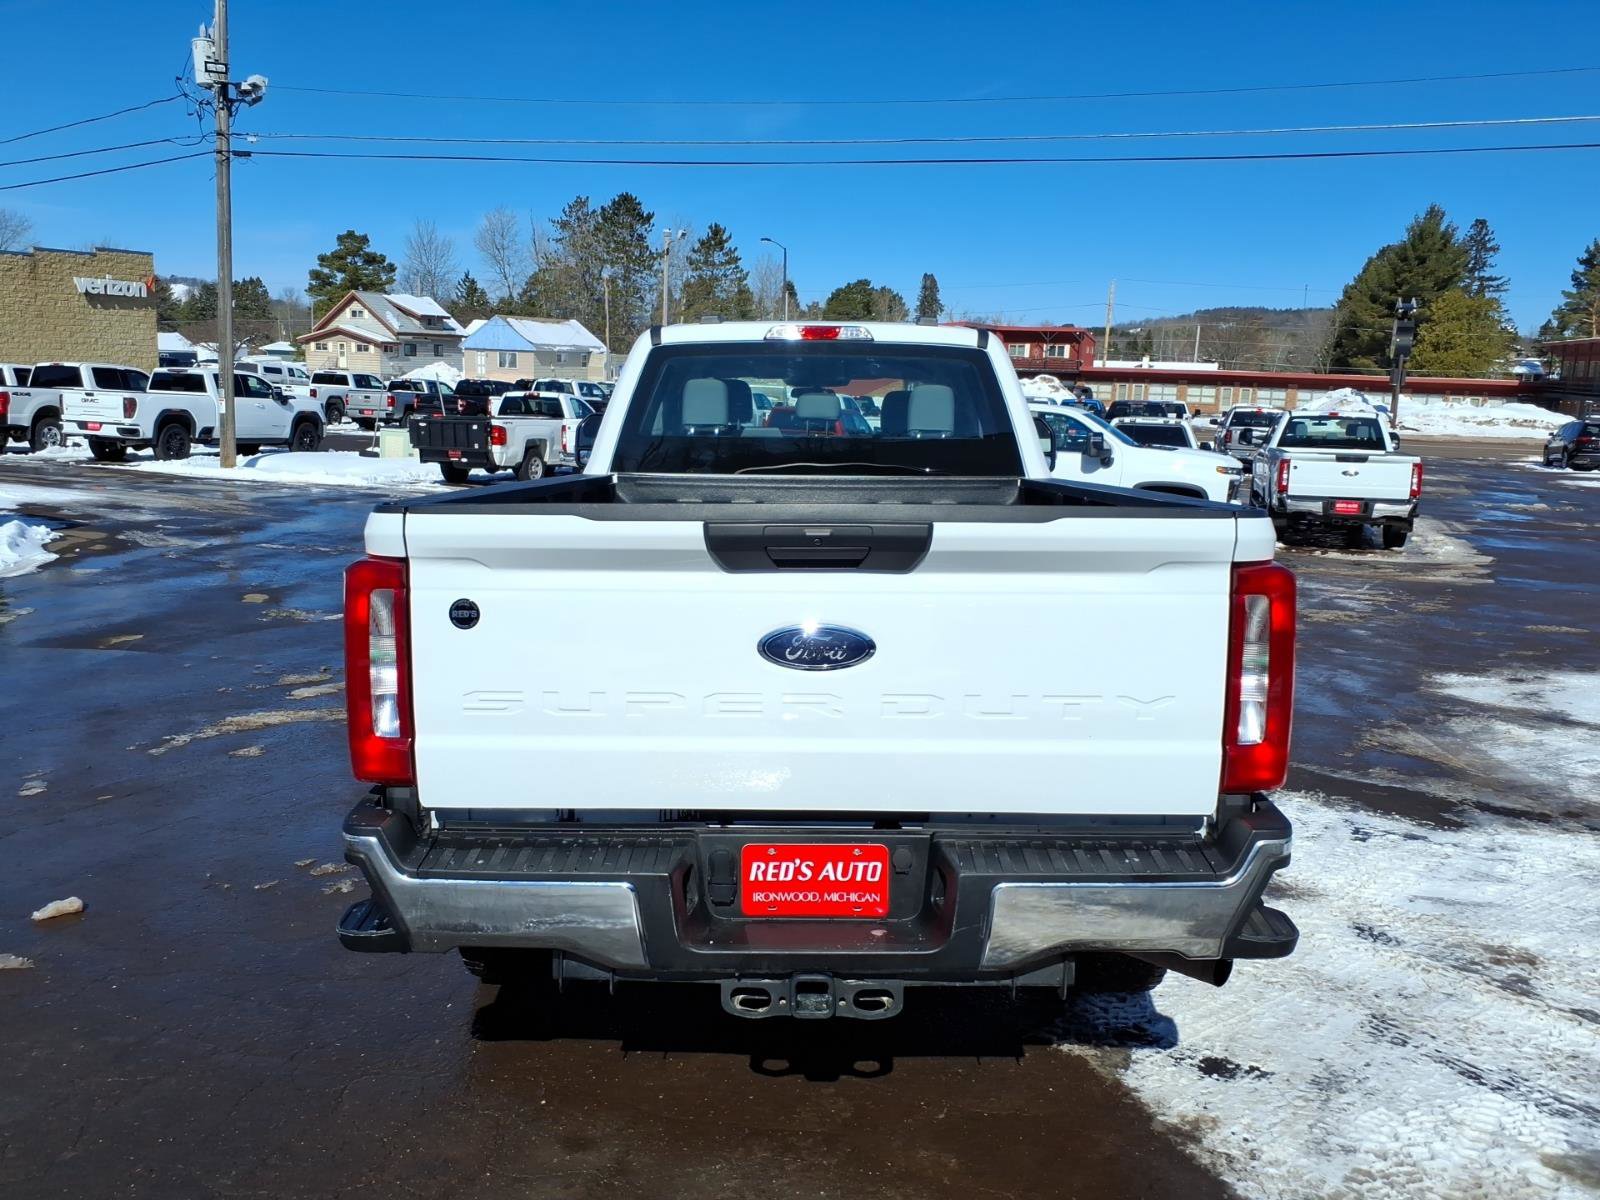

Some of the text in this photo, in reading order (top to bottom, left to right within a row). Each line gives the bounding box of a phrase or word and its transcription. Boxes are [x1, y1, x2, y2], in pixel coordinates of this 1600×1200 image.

[73, 274, 147, 297] verizon
[785, 634, 848, 661] Ford
[462, 690, 1176, 721] SUPER DUTY
[749, 858, 883, 882] RED'S AUTO
[752, 891, 881, 903] IRONWOOD, MICHIGAN
